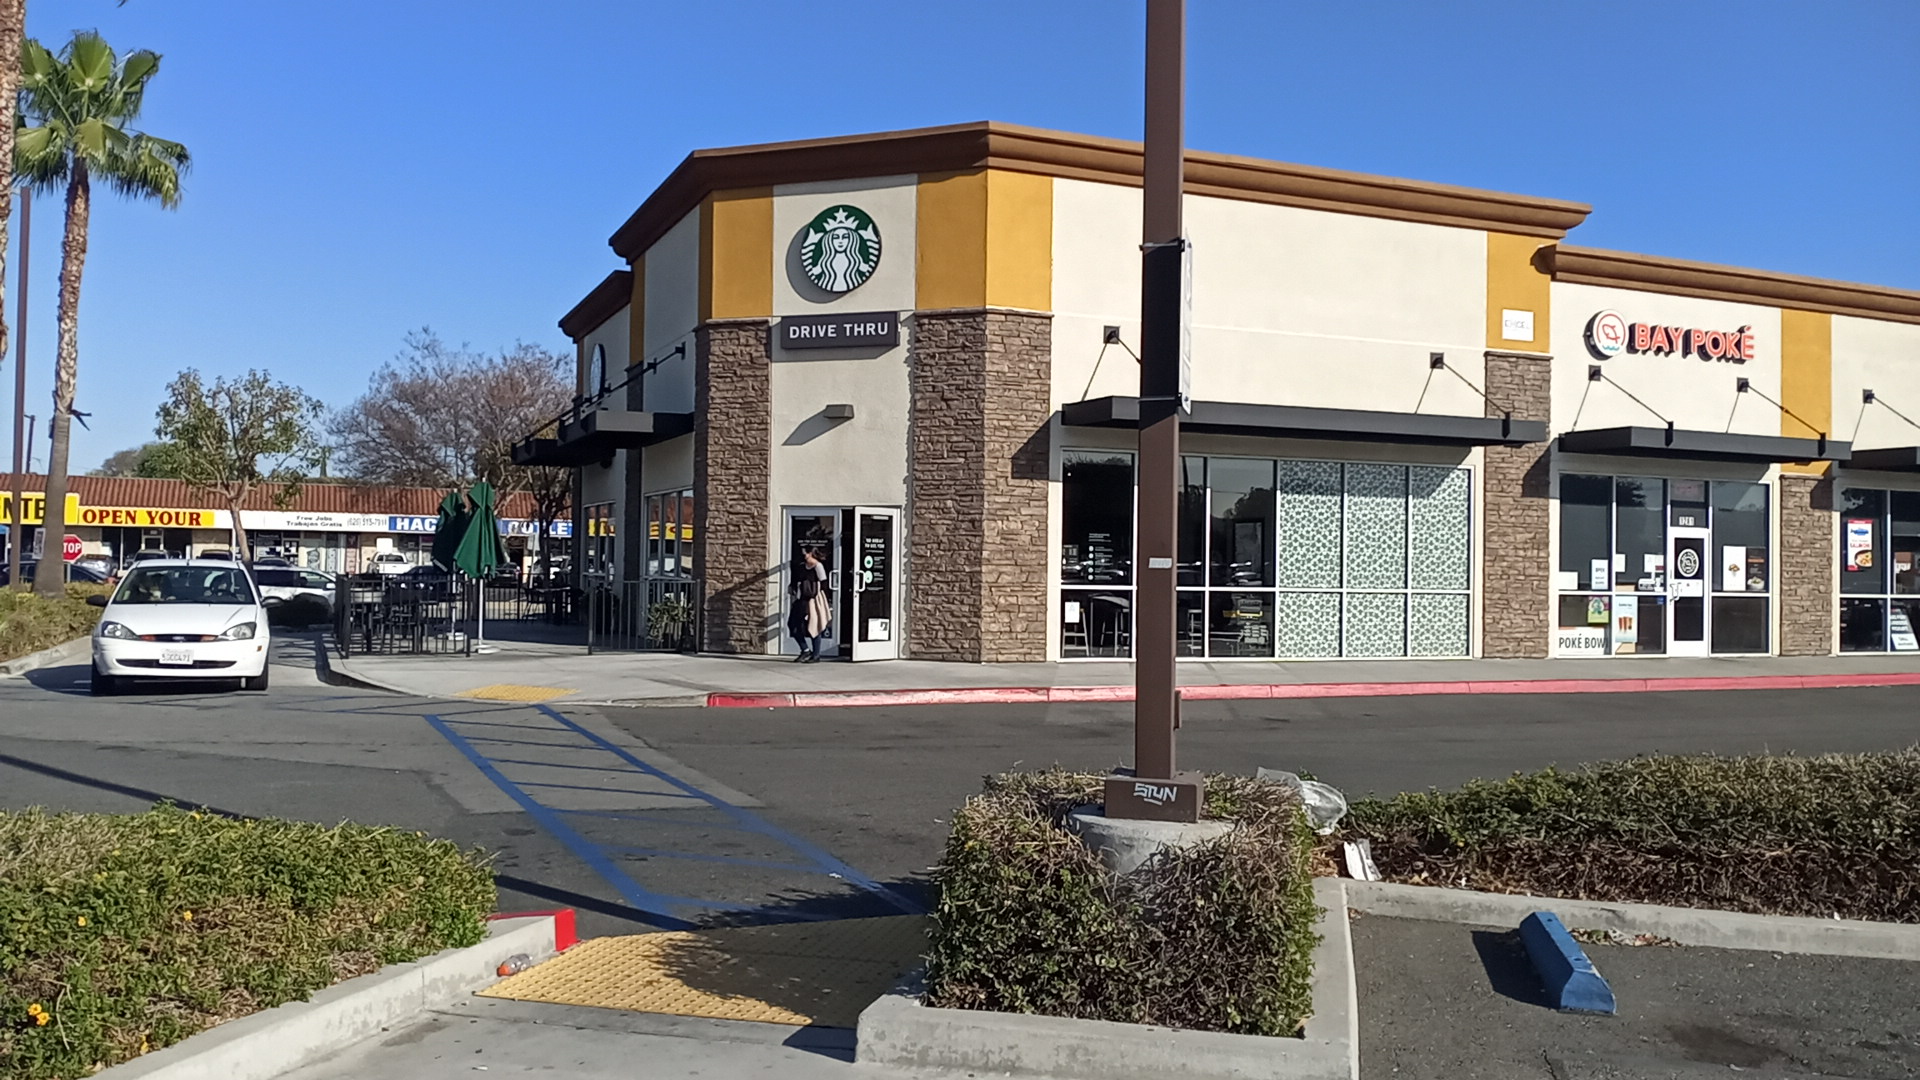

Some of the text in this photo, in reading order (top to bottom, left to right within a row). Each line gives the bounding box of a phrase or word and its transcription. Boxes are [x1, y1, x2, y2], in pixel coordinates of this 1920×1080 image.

[789, 321, 889, 339] DRIVE THRU
[1633, 322, 1755, 360] BAY POKÉ
[82, 508, 202, 527] OPEN YOUR
[63, 542, 82, 554] TOP
[1558, 633, 1583, 649] POKÉ
[1133, 783, 1178, 803] STUN
